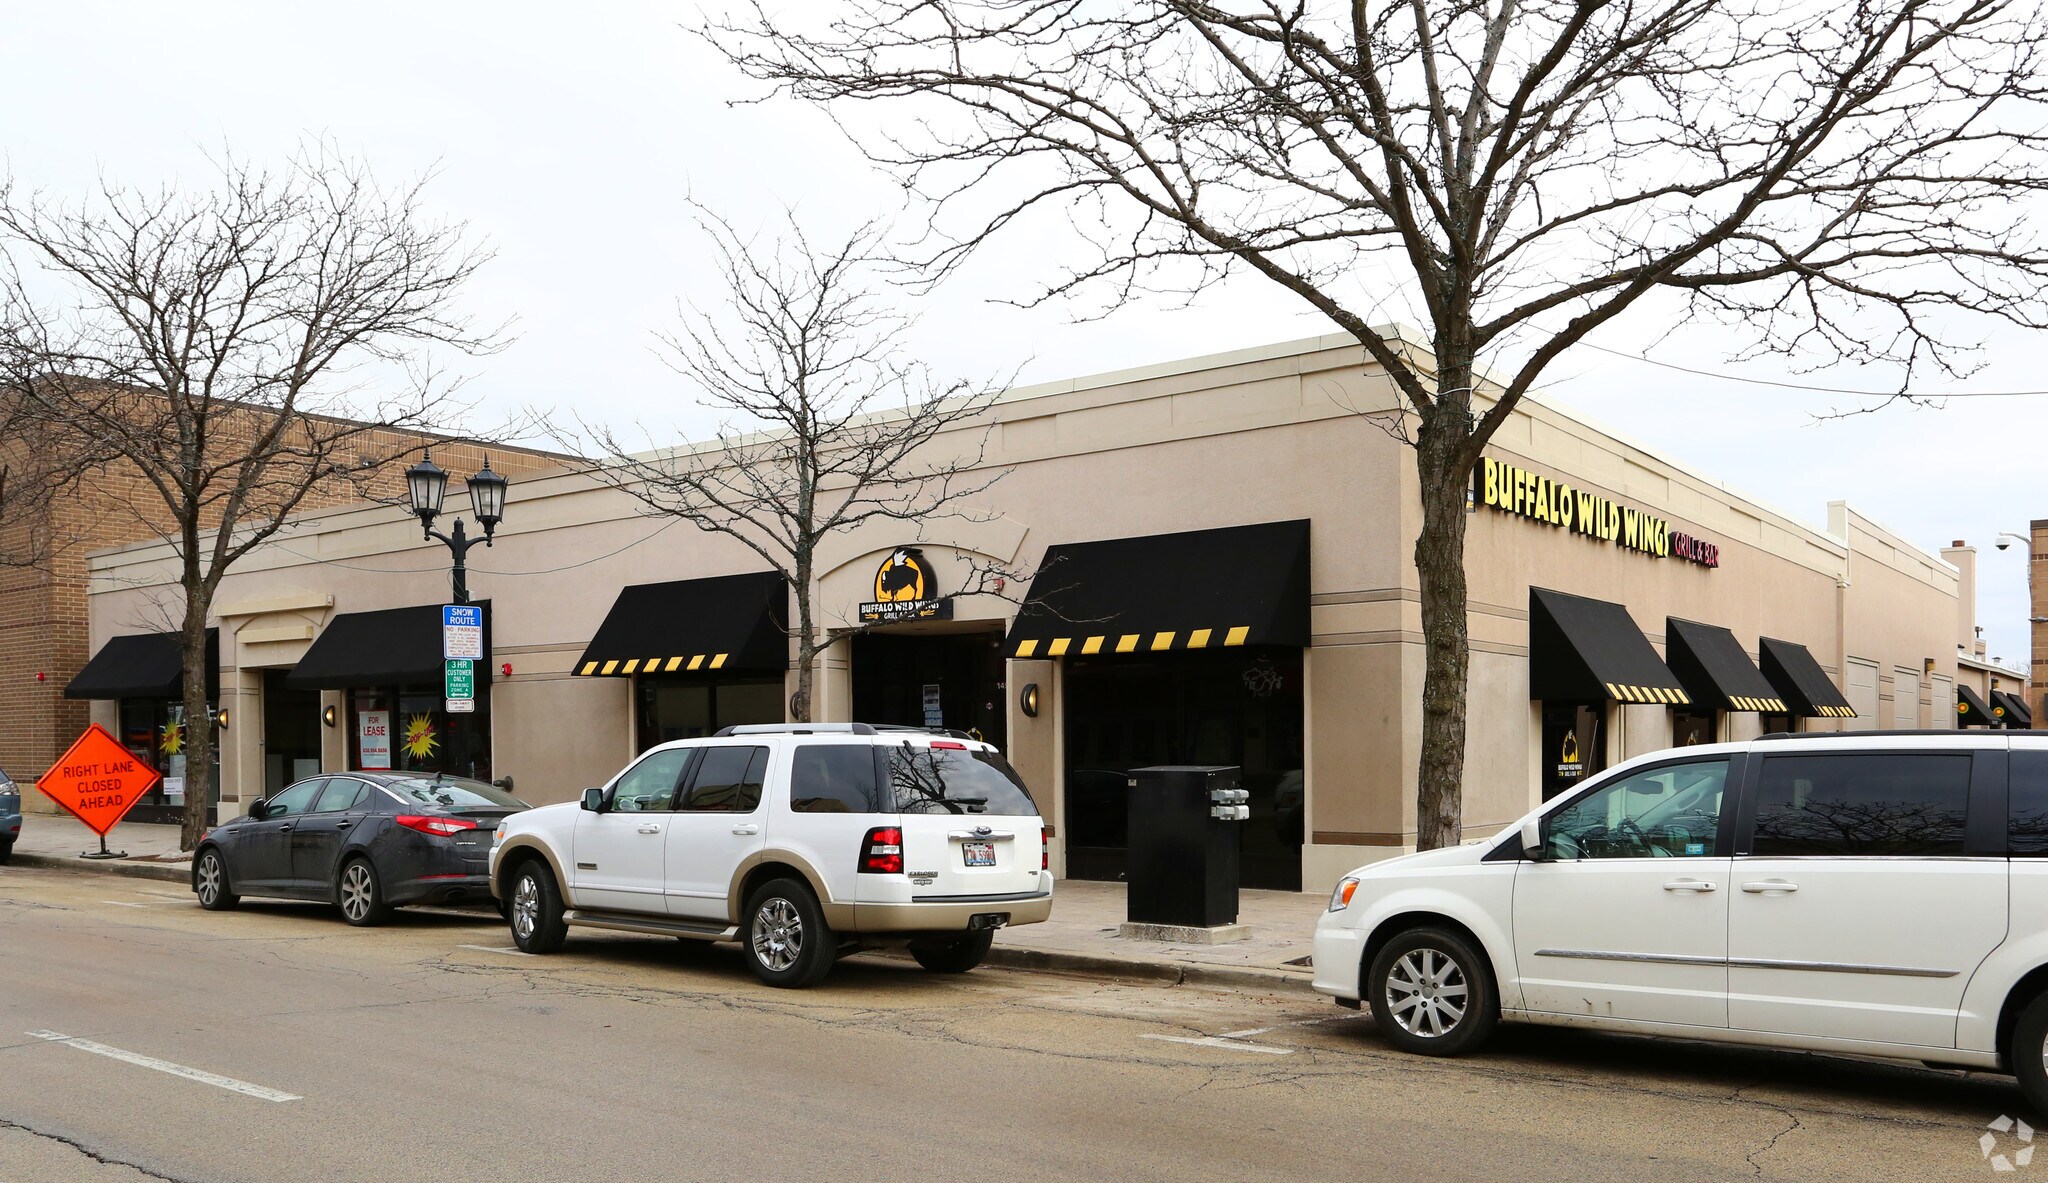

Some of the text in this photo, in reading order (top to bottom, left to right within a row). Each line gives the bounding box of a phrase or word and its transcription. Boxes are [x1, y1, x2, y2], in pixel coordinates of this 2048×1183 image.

[1485, 457, 1669, 558] BUFFALO WILD WINGS
[1675, 532, 1719, 567] GRILL & BAR
[451, 608, 474, 616] SNOW
[861, 603, 893, 613] BUFFALO
[894, 601, 914, 611] WILD
[450, 617, 475, 625] ROUTE
[451, 661, 468, 669] 3 HR
[368, 716, 379, 724] FOR
[363, 726, 386, 736] LEASE
[63, 760, 135, 778] RIGHT LANE
[77, 779, 122, 793] CLOSED
[78, 795, 123, 810] AHEAD
